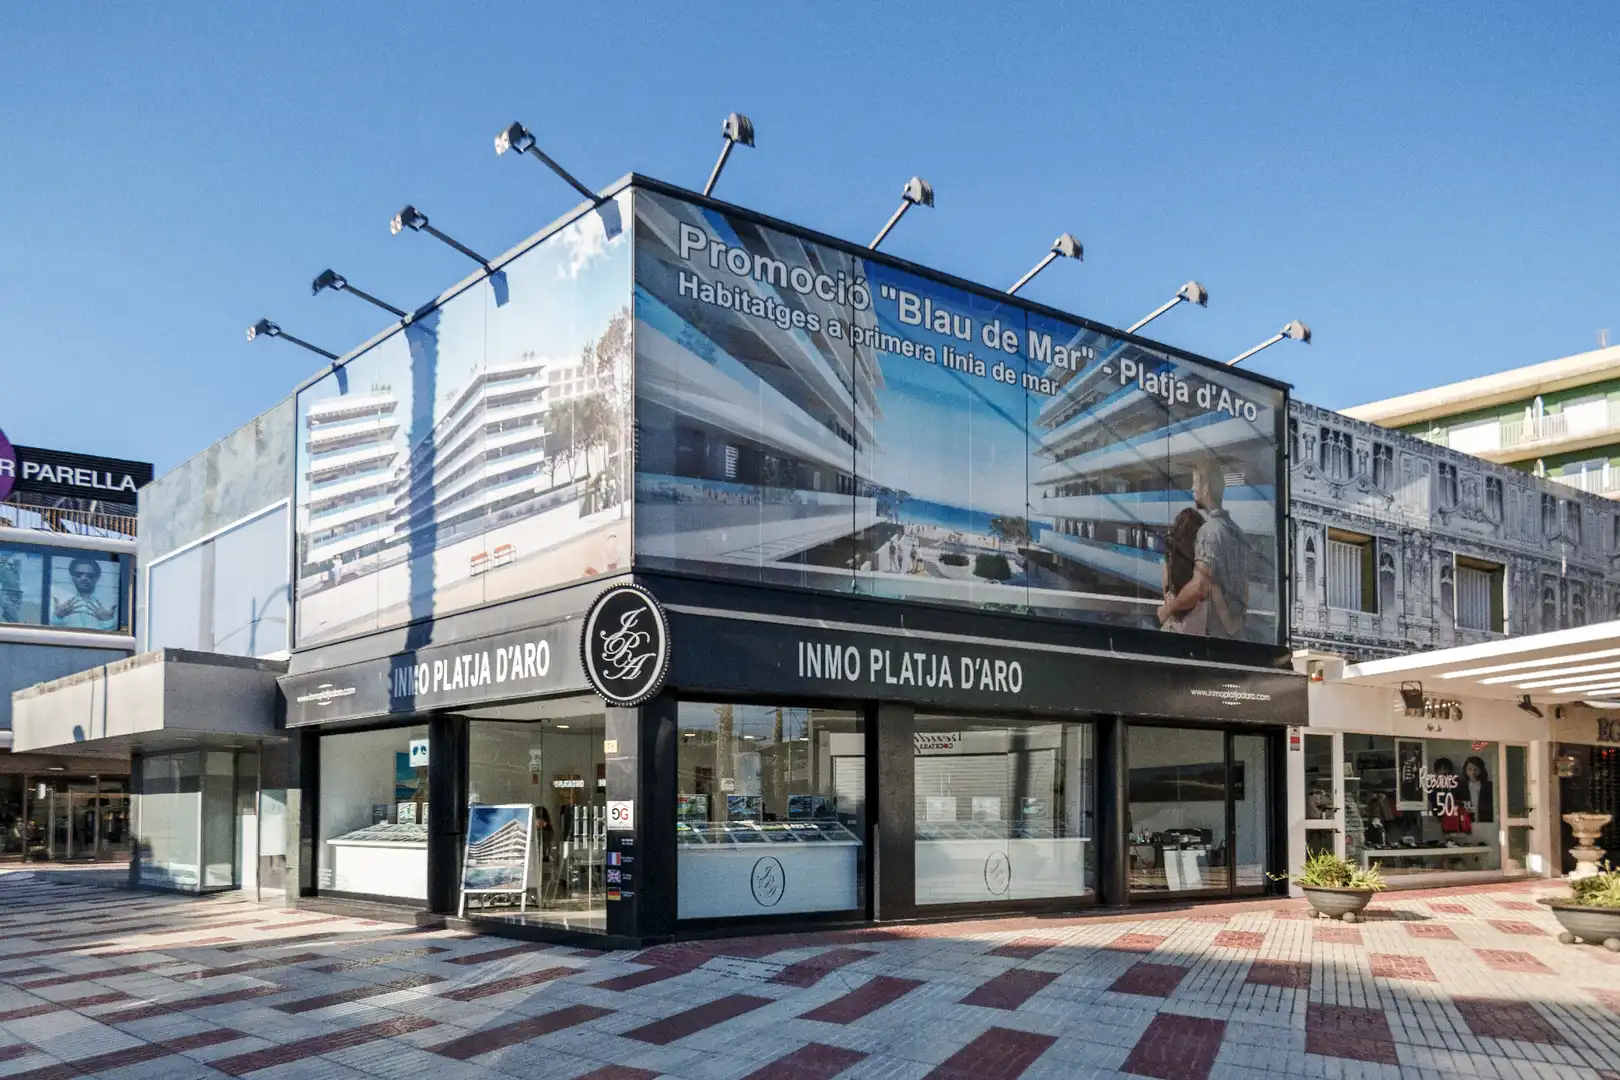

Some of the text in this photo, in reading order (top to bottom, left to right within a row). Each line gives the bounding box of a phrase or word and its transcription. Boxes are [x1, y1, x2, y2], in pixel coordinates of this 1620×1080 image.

[679, 272, 1060, 396] Habitatges a primera línia de mar
[680, 222, 1257, 422] Promoció "Blau de Mar" - Platja d'Aro
[22, 461, 138, 492] PARELLA
[394, 639, 550, 698] INMO PLATJA D'ARO
[799, 641, 1023, 693] INMO PLATJA D'ARO
